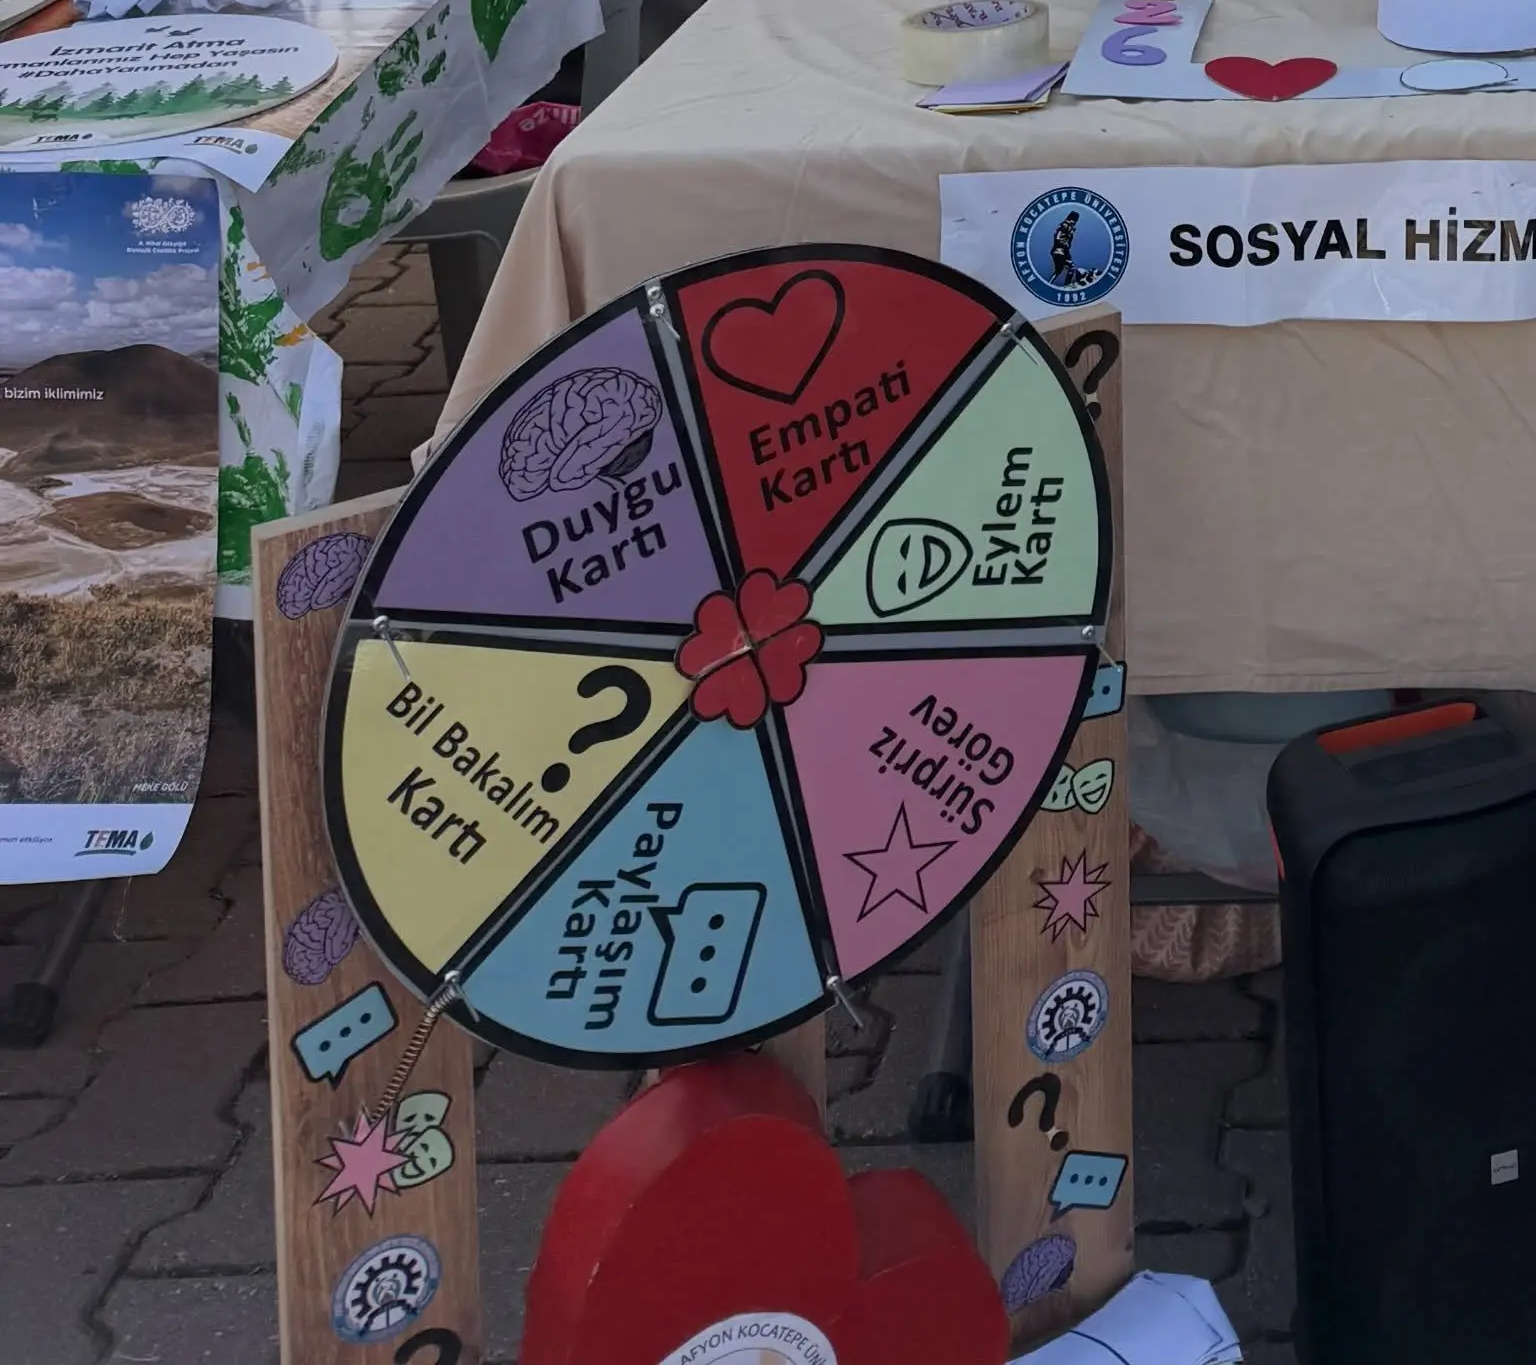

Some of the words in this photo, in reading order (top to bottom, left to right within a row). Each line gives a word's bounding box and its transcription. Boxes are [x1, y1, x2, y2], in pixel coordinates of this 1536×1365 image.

[149, 52, 201, 61] Hep
[163, 39, 245, 49] Atma
[1019, 191, 1077, 233] KOCATEPE
[1169, 217, 1386, 268] SOSYAL
[1016, 241, 1036, 283] AFYON
[4, 387, 41, 399] bizim
[44, 387, 104, 400] iklimimiz
[748, 359, 913, 467] Empati
[522, 462, 683, 565] Duygu
[760, 440, 873, 513] Kartı
[974, 446, 1033, 588] Eylem
[547, 523, 668, 604] Kartı
[1012, 477, 1065, 587] Kartı
[386, 681, 443, 738] Bil
[433, 720, 560, 844] Bakalım
[869, 727, 994, 836] Sürpriz
[910, 693, 1015, 789] Görev
[84, 829, 139, 849] TEMA
[387, 767, 487, 865] Kartı
[545, 879, 615, 1000] Kartı
[584, 802, 684, 1030] Paylaşım
[681, 1328, 733, 1365] AFYON
[738, 1323, 809, 1350] KOCATEPE
